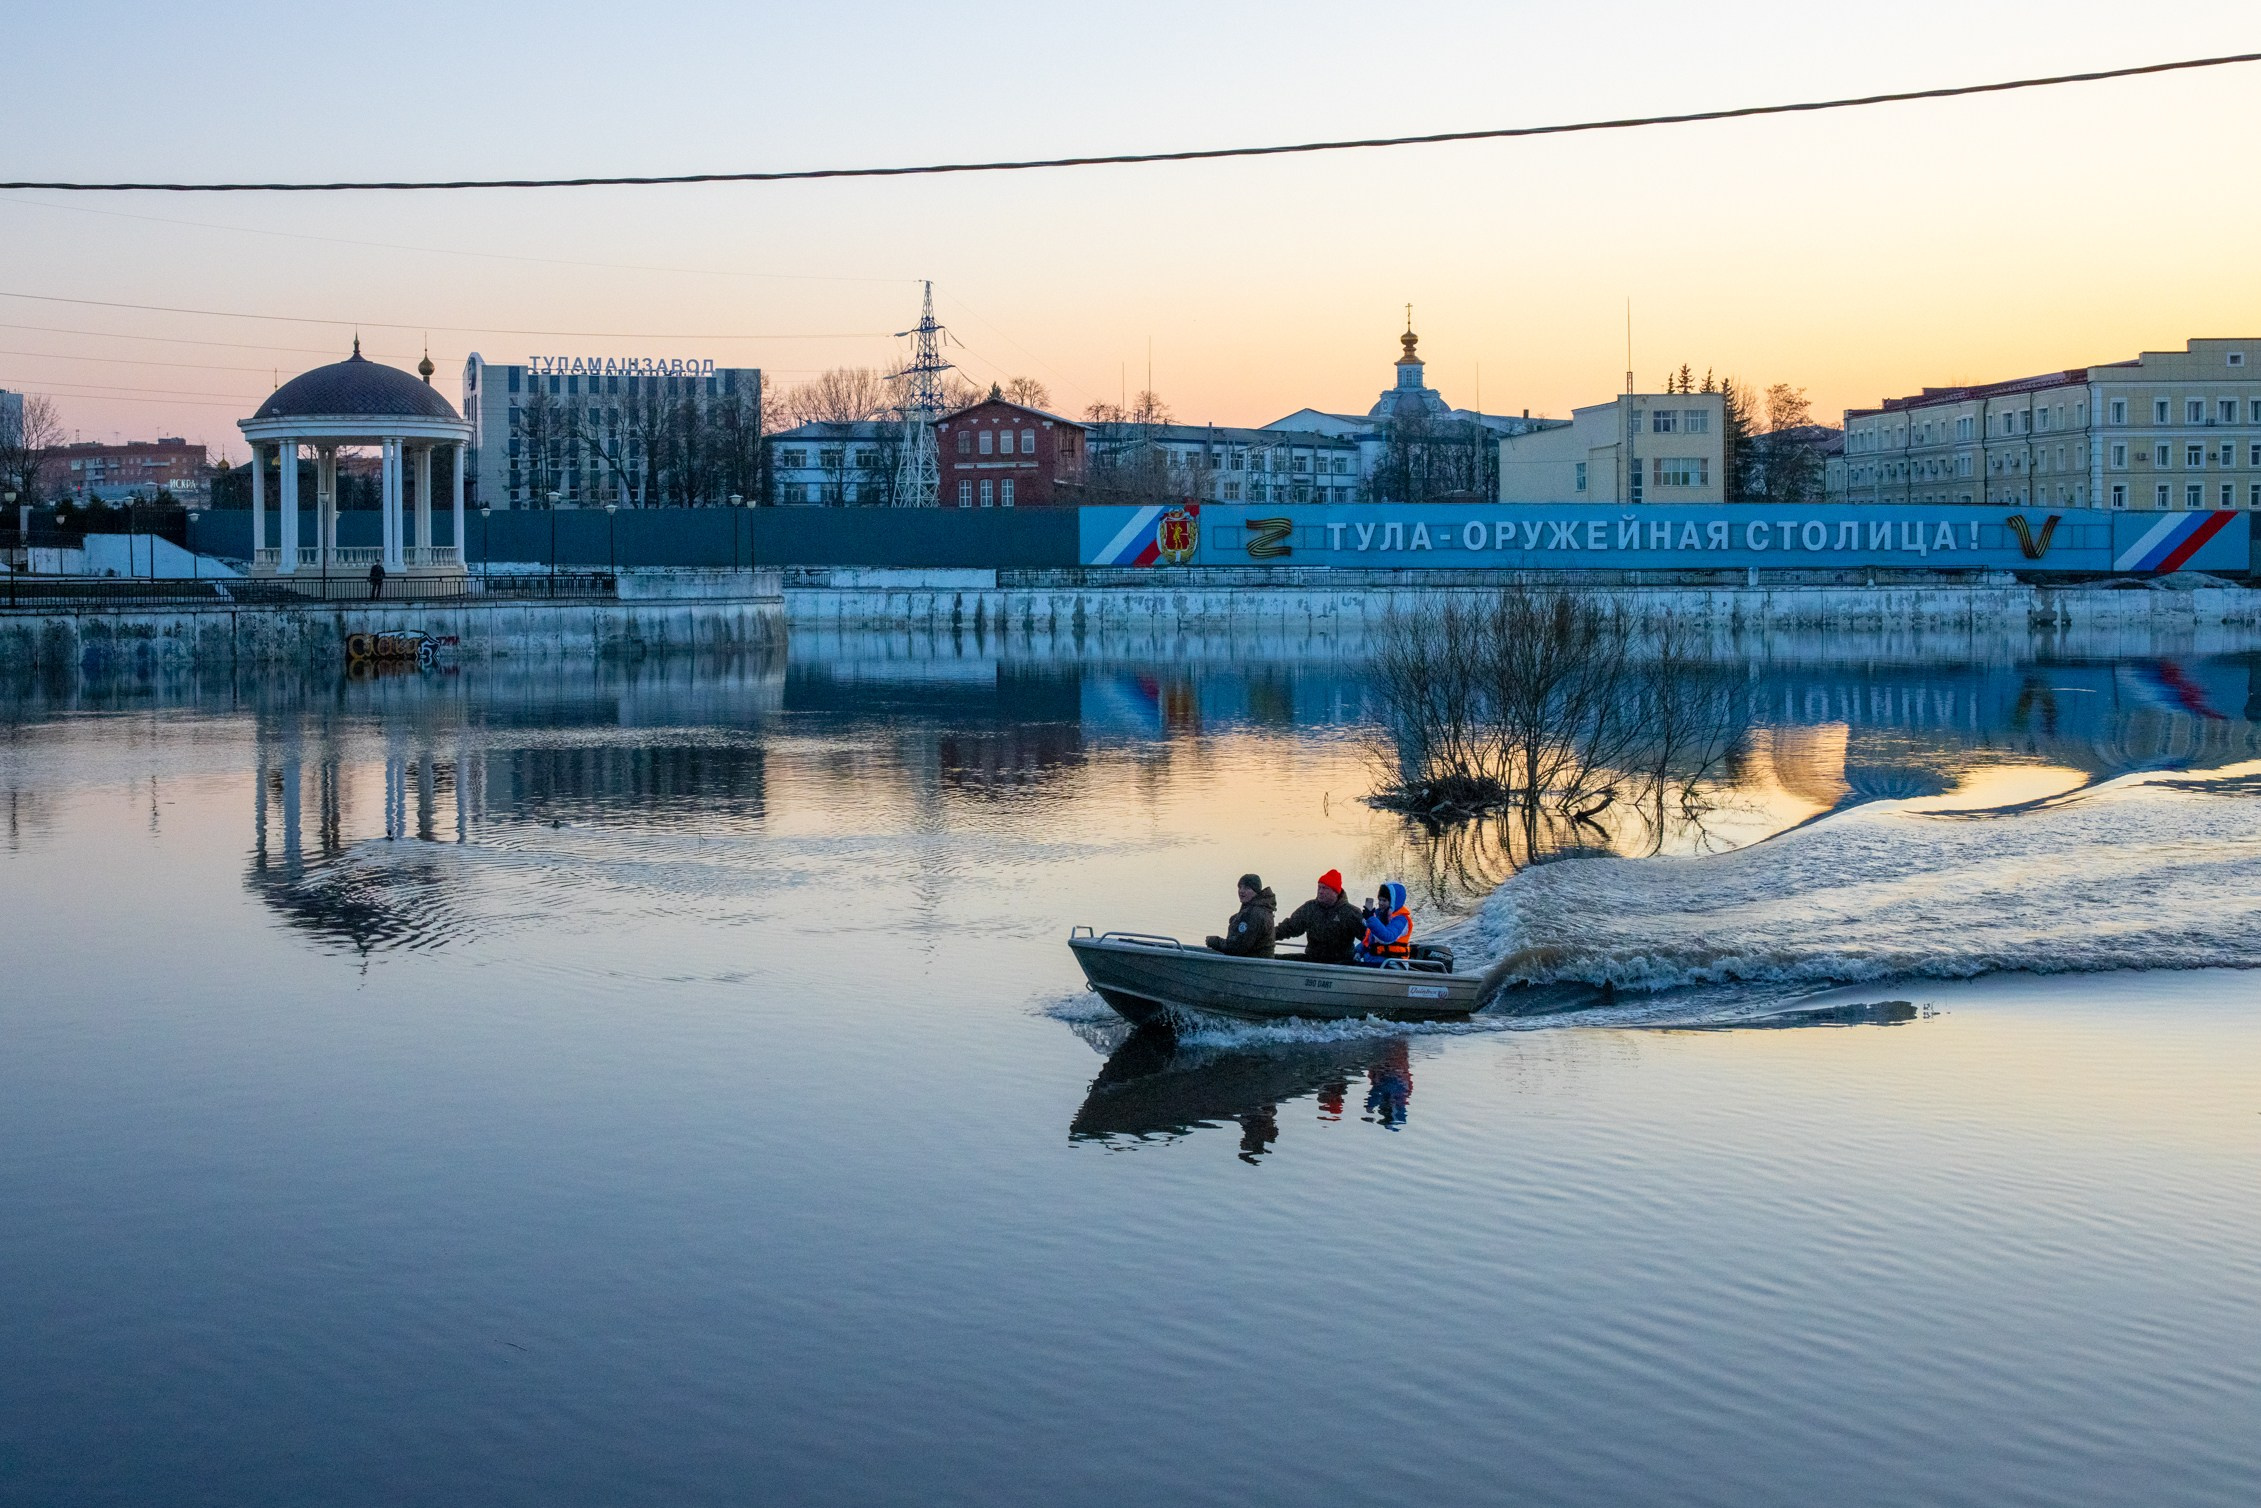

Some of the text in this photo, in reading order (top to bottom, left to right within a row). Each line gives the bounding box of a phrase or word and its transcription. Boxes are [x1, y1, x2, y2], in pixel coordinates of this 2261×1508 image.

[529, 356, 716, 376] ТУЛАМАШЗАВОД
[170, 479, 196, 489] ИСКРА
[1463, 514, 1729, 550] ОРУЖЕЙНАЯ
[1317, 980, 1333, 989] DART
